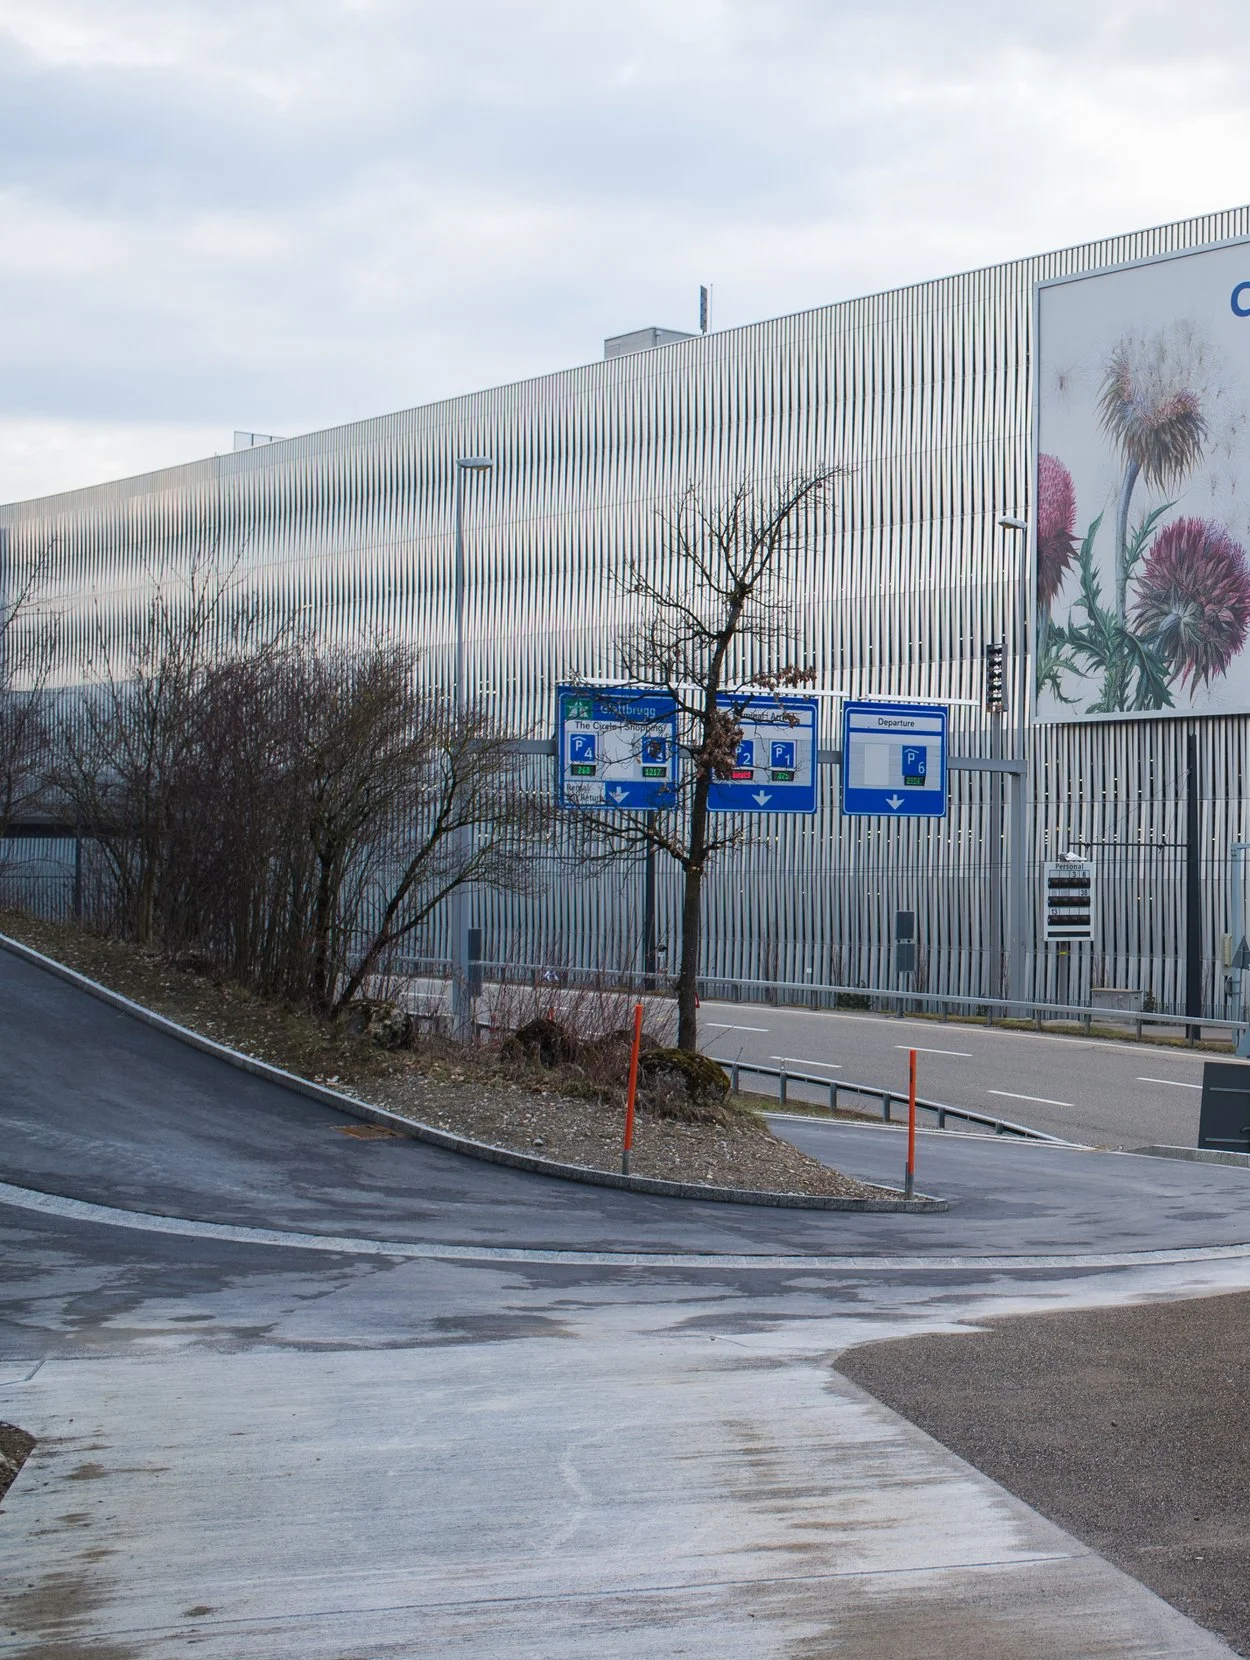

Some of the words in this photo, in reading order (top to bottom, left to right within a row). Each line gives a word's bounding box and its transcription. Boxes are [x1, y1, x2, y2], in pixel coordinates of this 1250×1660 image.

[575, 721, 590, 730] The
[878, 718, 915, 728] Departure
[575, 740, 583, 752] P
[584, 747, 593, 758] 4
[776, 747, 783, 758] P
[743, 752, 751, 765] 2
[907, 753, 915, 765] P
[918, 761, 925, 774] 6
